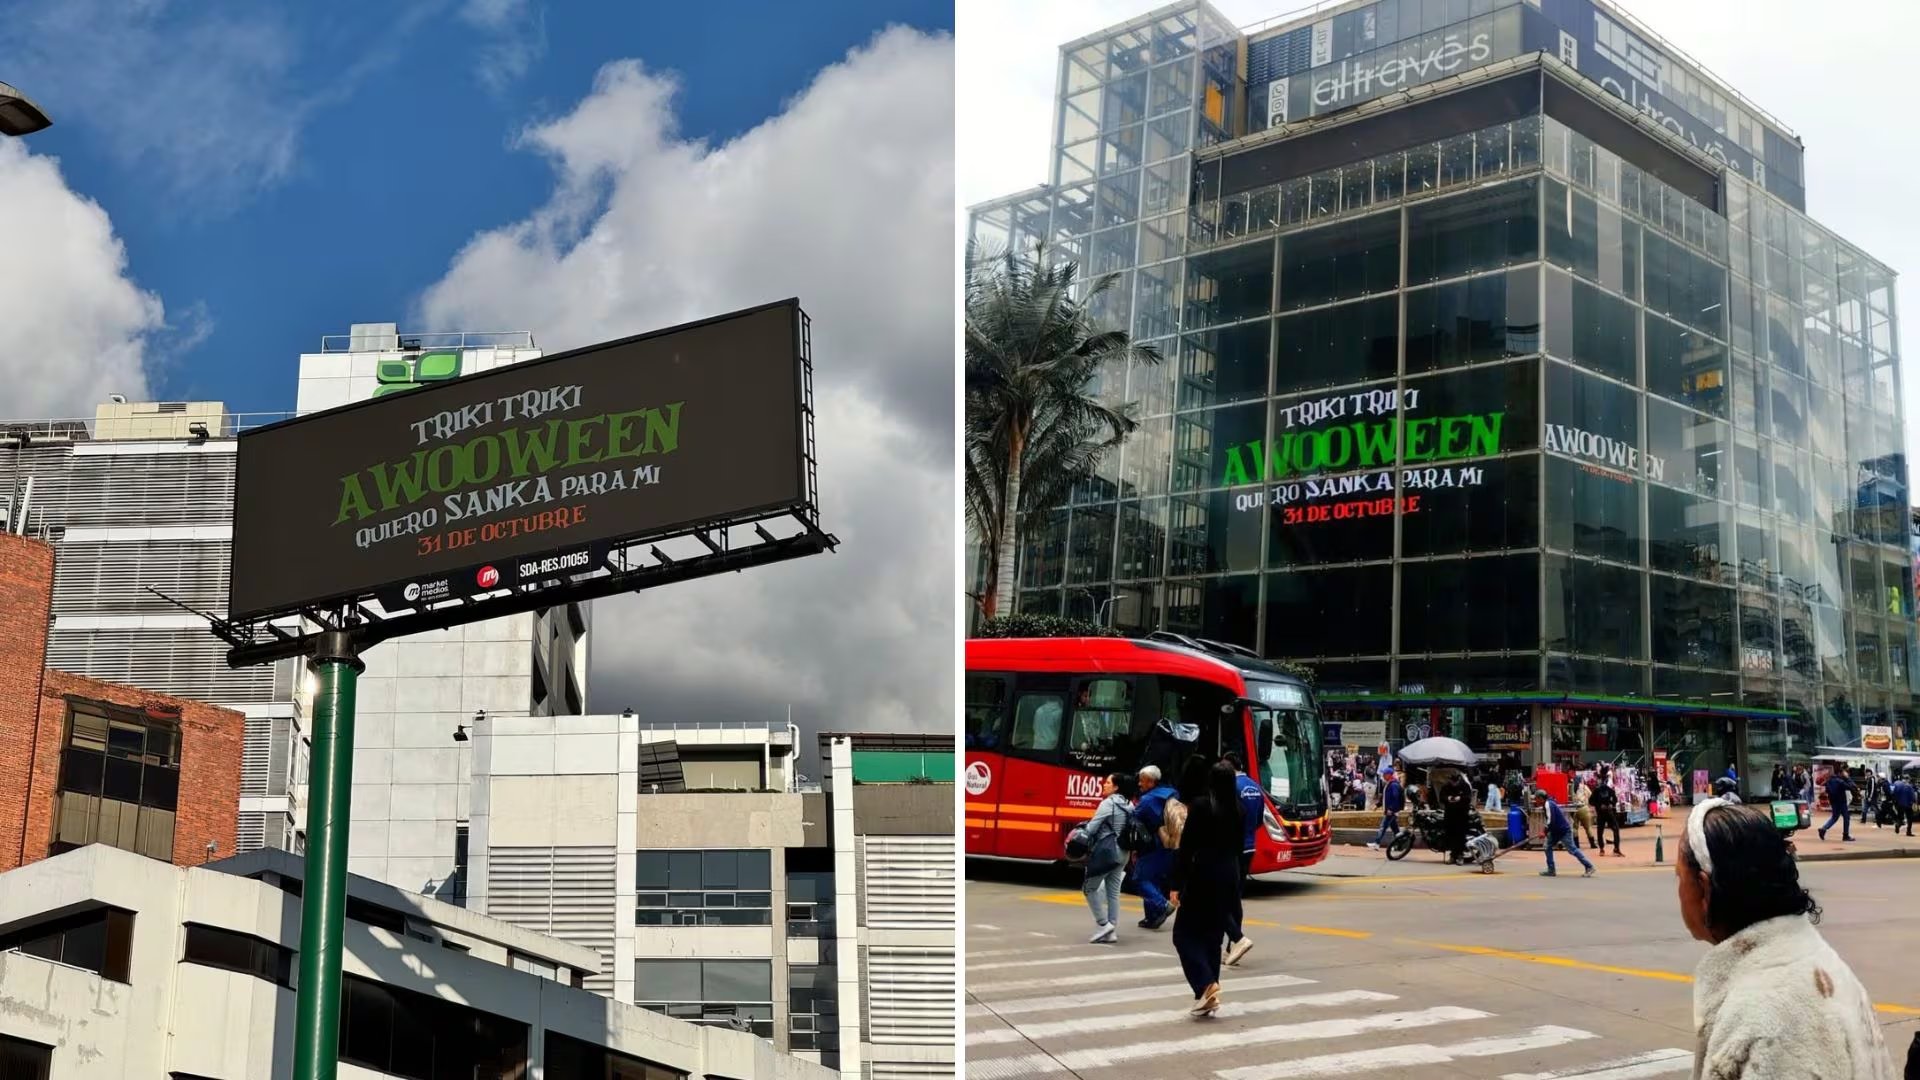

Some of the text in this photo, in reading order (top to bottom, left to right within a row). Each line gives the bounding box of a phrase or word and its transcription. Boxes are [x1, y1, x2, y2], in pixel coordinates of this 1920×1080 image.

[410, 384, 584, 446] TRIKI TRIKI
[1280, 395, 1346, 429] TRIKI
[329, 401, 686, 528] AWOOWEEN
[1222, 412, 1504, 487] AWOOWEEN
[1305, 472, 1394, 499] SANKA
[1402, 467, 1455, 490] PARA
[1457, 466, 1484, 488] MI
[355, 464, 662, 549] QUIERO SANKA PARA MI
[1283, 507, 1303, 525] 31
[1307, 504, 1332, 522] DE
[416, 504, 587, 557] 31 DE OCTUBRE
[518, 550, 590, 578] SDA-RES.01055
[421, 579, 449, 590] market
[421, 586, 450, 597] medios
[1067, 774, 1104, 797] K1605
